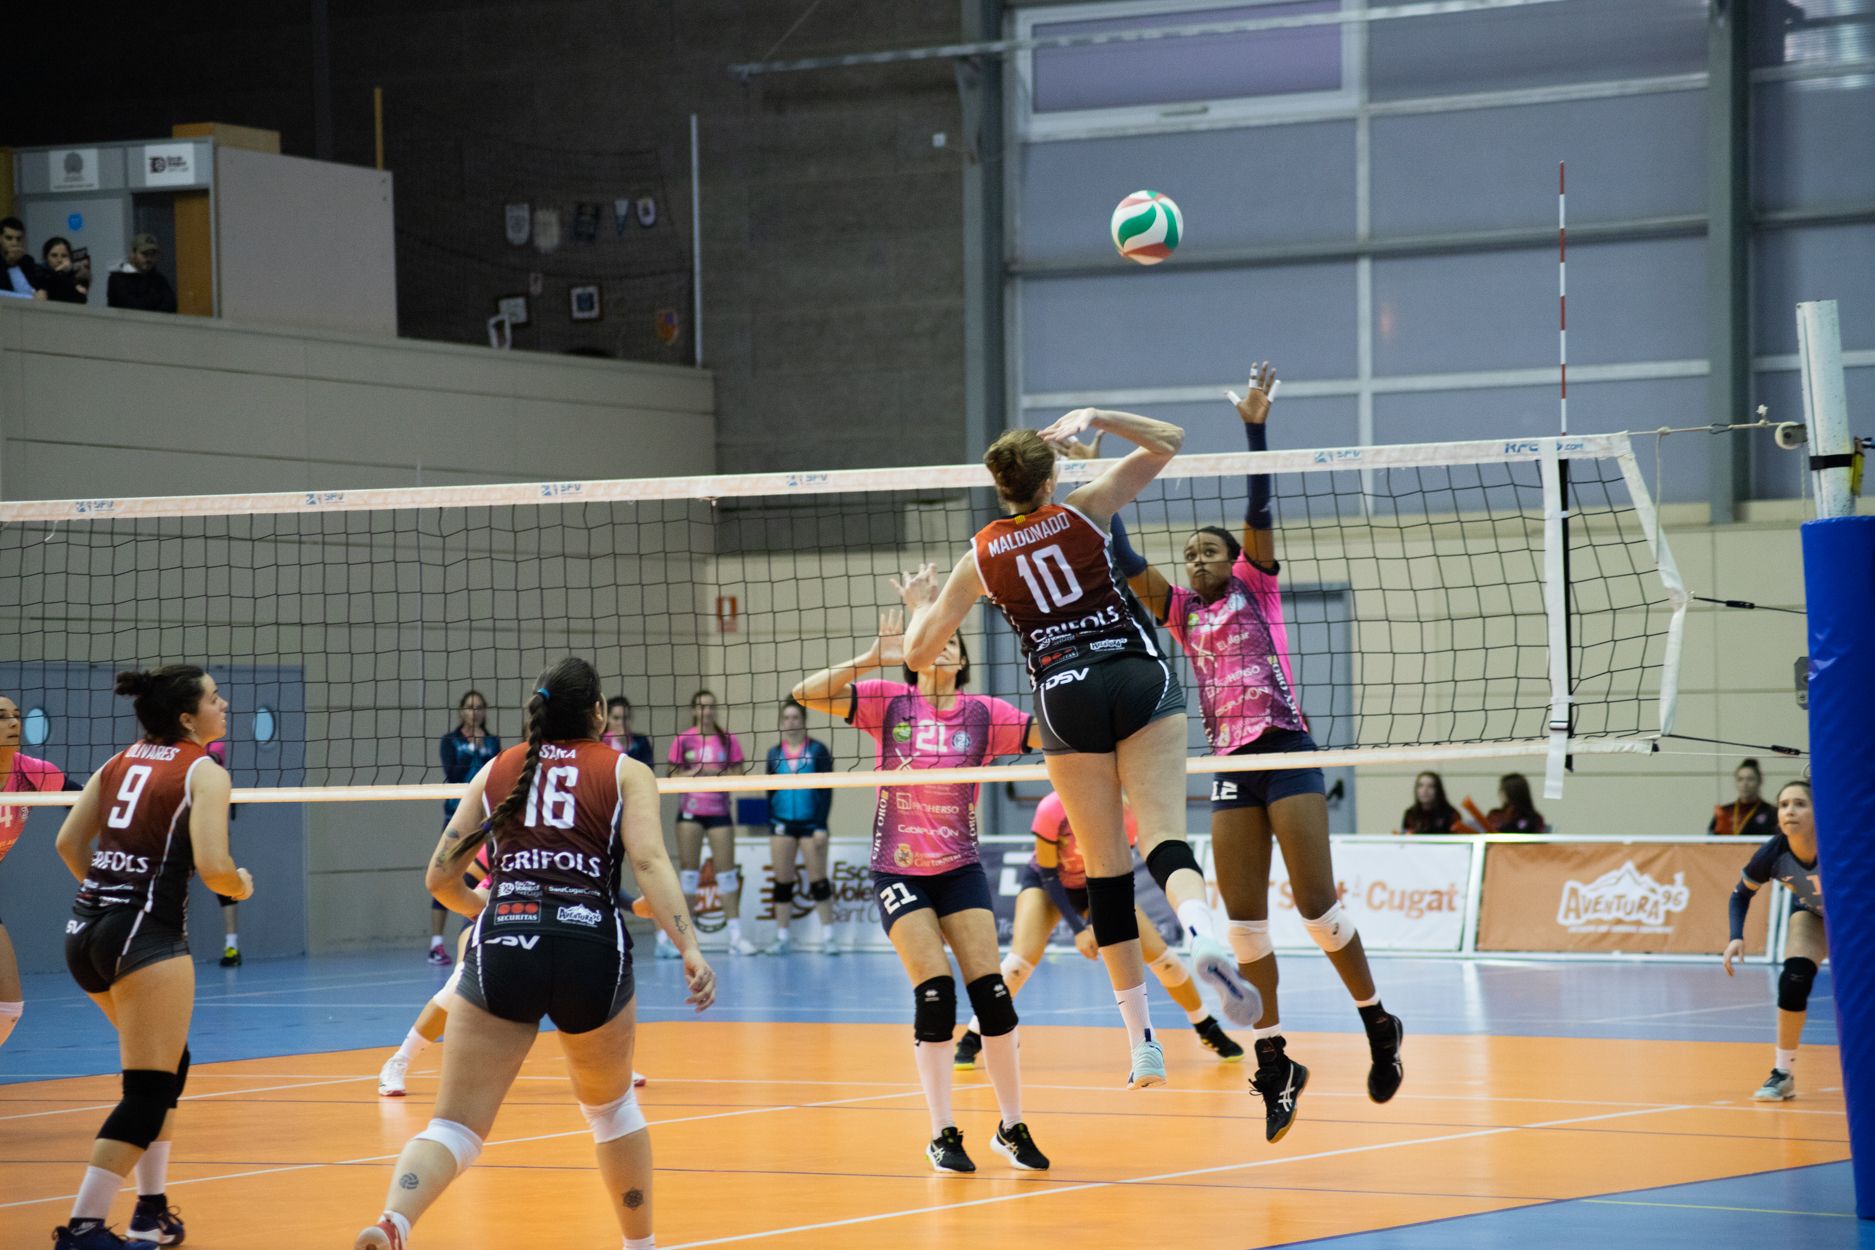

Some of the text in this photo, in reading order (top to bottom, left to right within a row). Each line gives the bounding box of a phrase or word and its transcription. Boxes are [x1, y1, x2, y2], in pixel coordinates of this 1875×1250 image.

[988, 512, 1070, 557] MALDONADO
[1016, 544, 1083, 614] 10
[1045, 667, 1090, 691] DSV
[915, 719, 948, 753] 21
[107, 764, 152, 829] 9
[524, 762, 579, 829] 16
[501, 849, 601, 878] GRIFOLS
[880, 882, 918, 915] 21
[1366, 881, 1459, 920] Cugat
[66, 919, 87, 934] SV
[484, 935, 540, 950] SV
